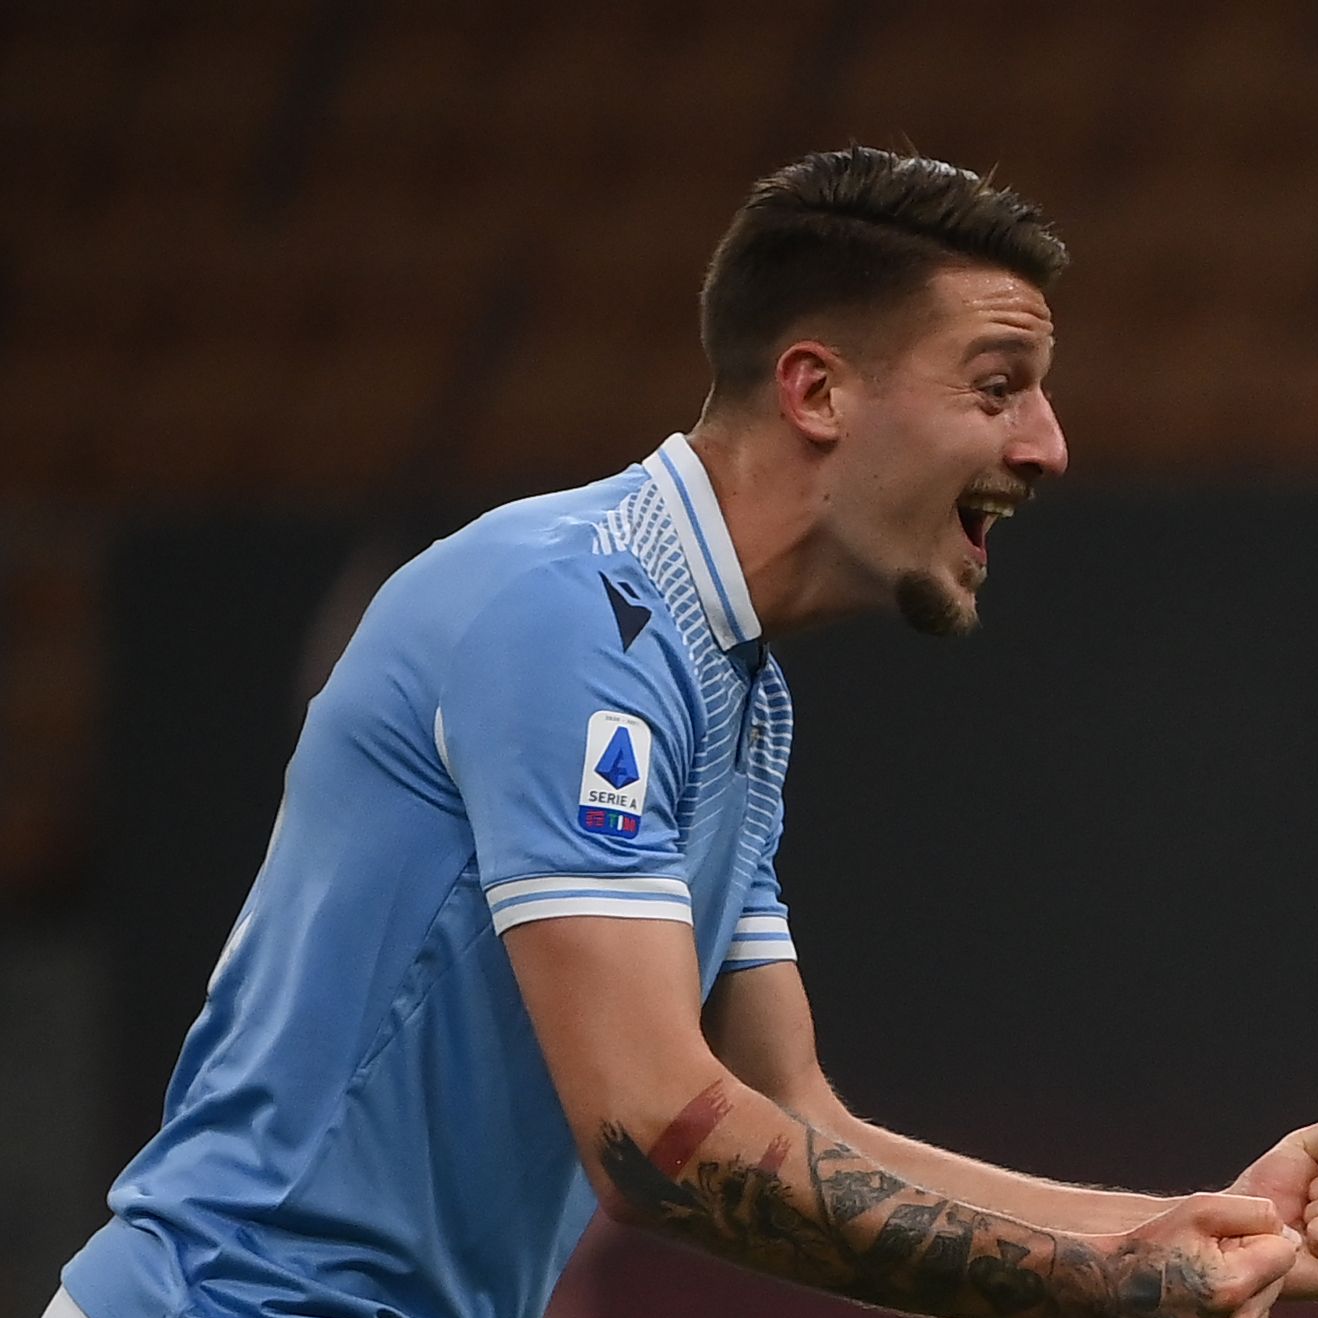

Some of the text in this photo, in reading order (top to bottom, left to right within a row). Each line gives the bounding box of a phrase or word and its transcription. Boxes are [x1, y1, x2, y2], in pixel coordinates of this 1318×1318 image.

[588, 790, 637, 810] SERIE A
[607, 812, 637, 832] TIM
